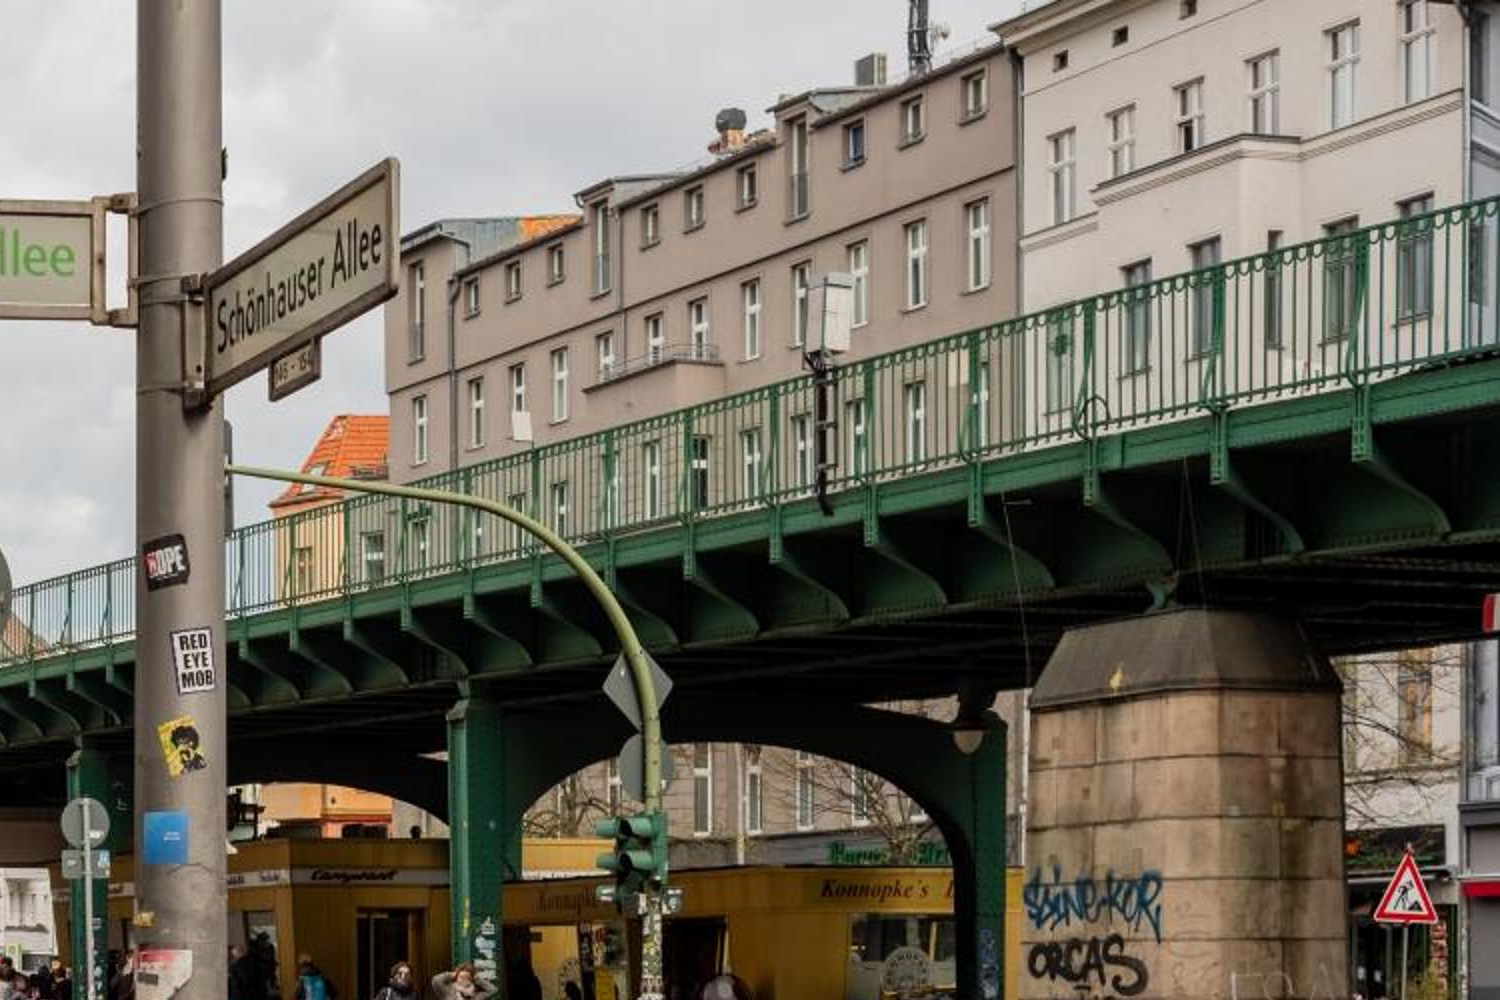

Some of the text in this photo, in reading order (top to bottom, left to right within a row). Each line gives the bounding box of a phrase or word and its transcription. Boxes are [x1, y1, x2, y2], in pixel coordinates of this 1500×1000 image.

[217, 217, 382, 353] Schönhauser Allee
[179, 633, 208, 651] RED
[183, 651, 209, 669] EYE
[181, 670, 214, 689] MOB
[820, 879, 930, 903] Konnopke's
